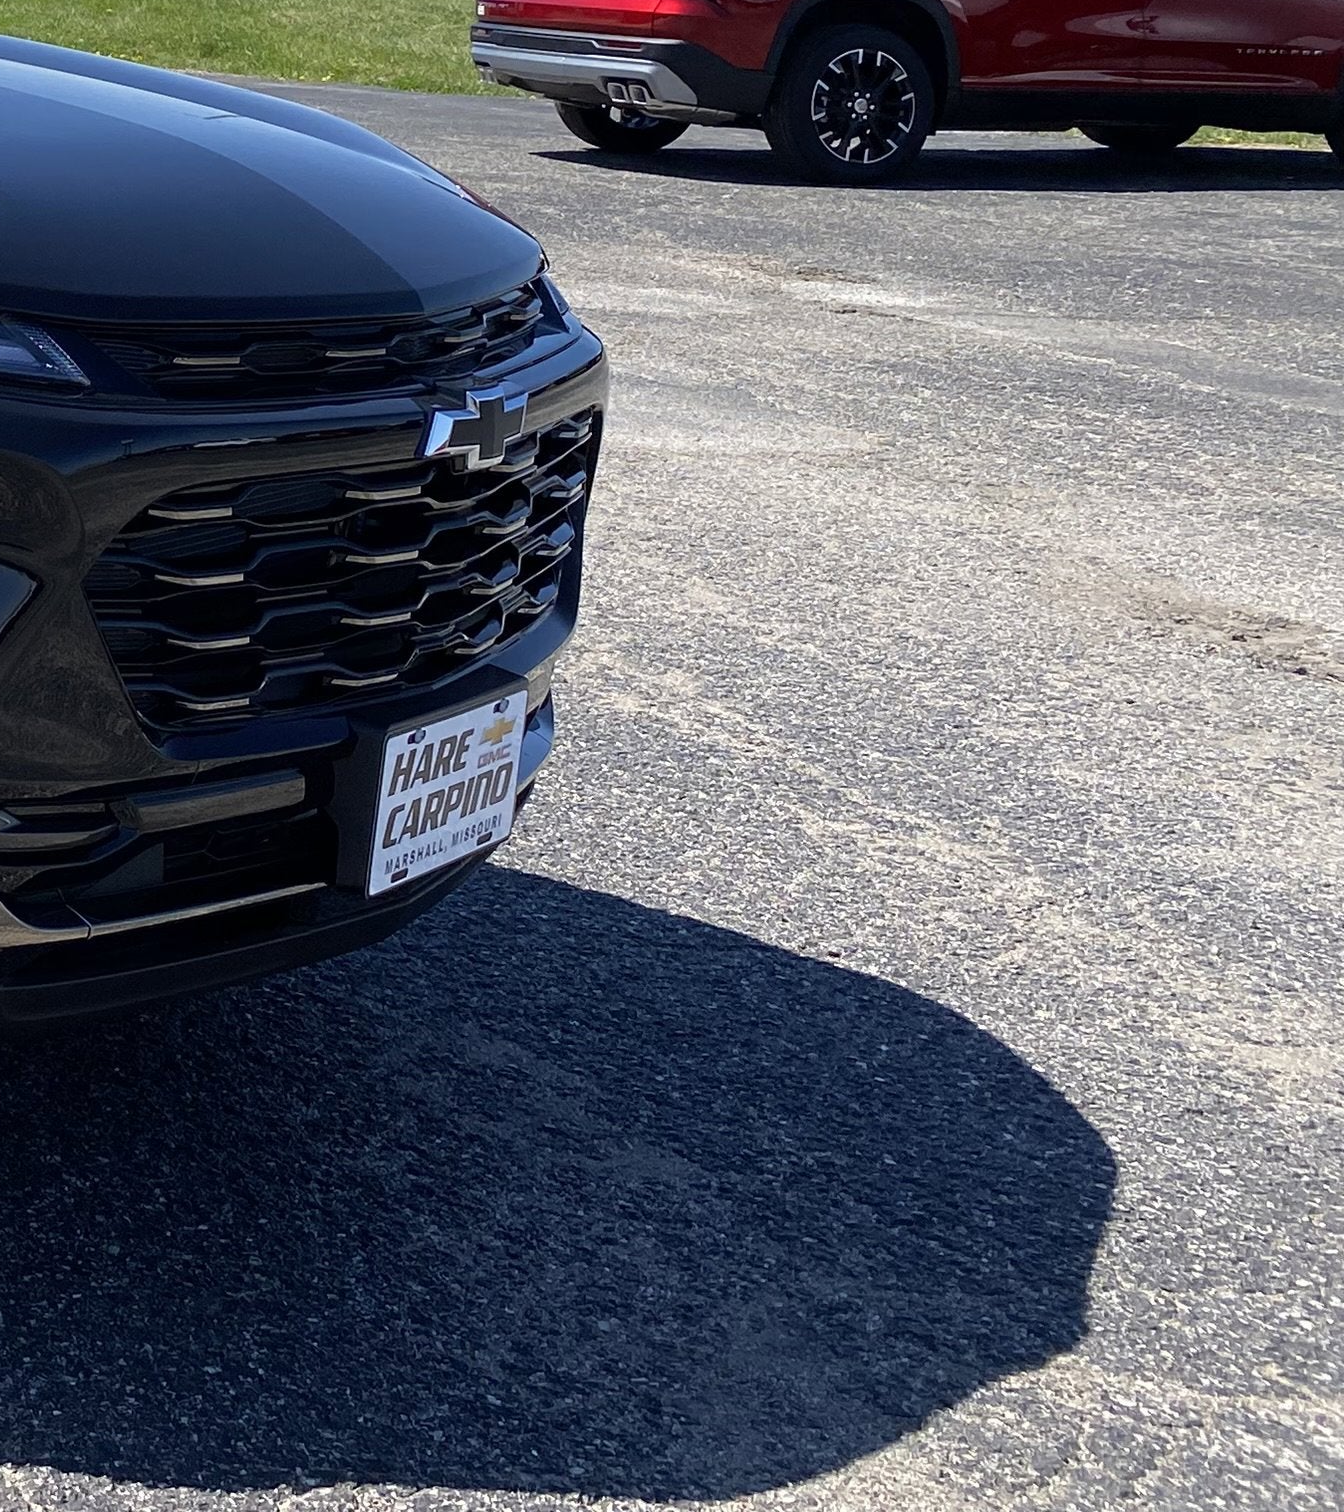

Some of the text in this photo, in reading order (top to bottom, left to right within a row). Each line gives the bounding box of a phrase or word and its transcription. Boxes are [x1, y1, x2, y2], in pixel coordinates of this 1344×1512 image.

[387, 728, 475, 797] HARE
[477, 743, 512, 769] GMC
[382, 760, 514, 850] CARPINO
[385, 813, 502, 874] MARSHALL, MISSOURI
